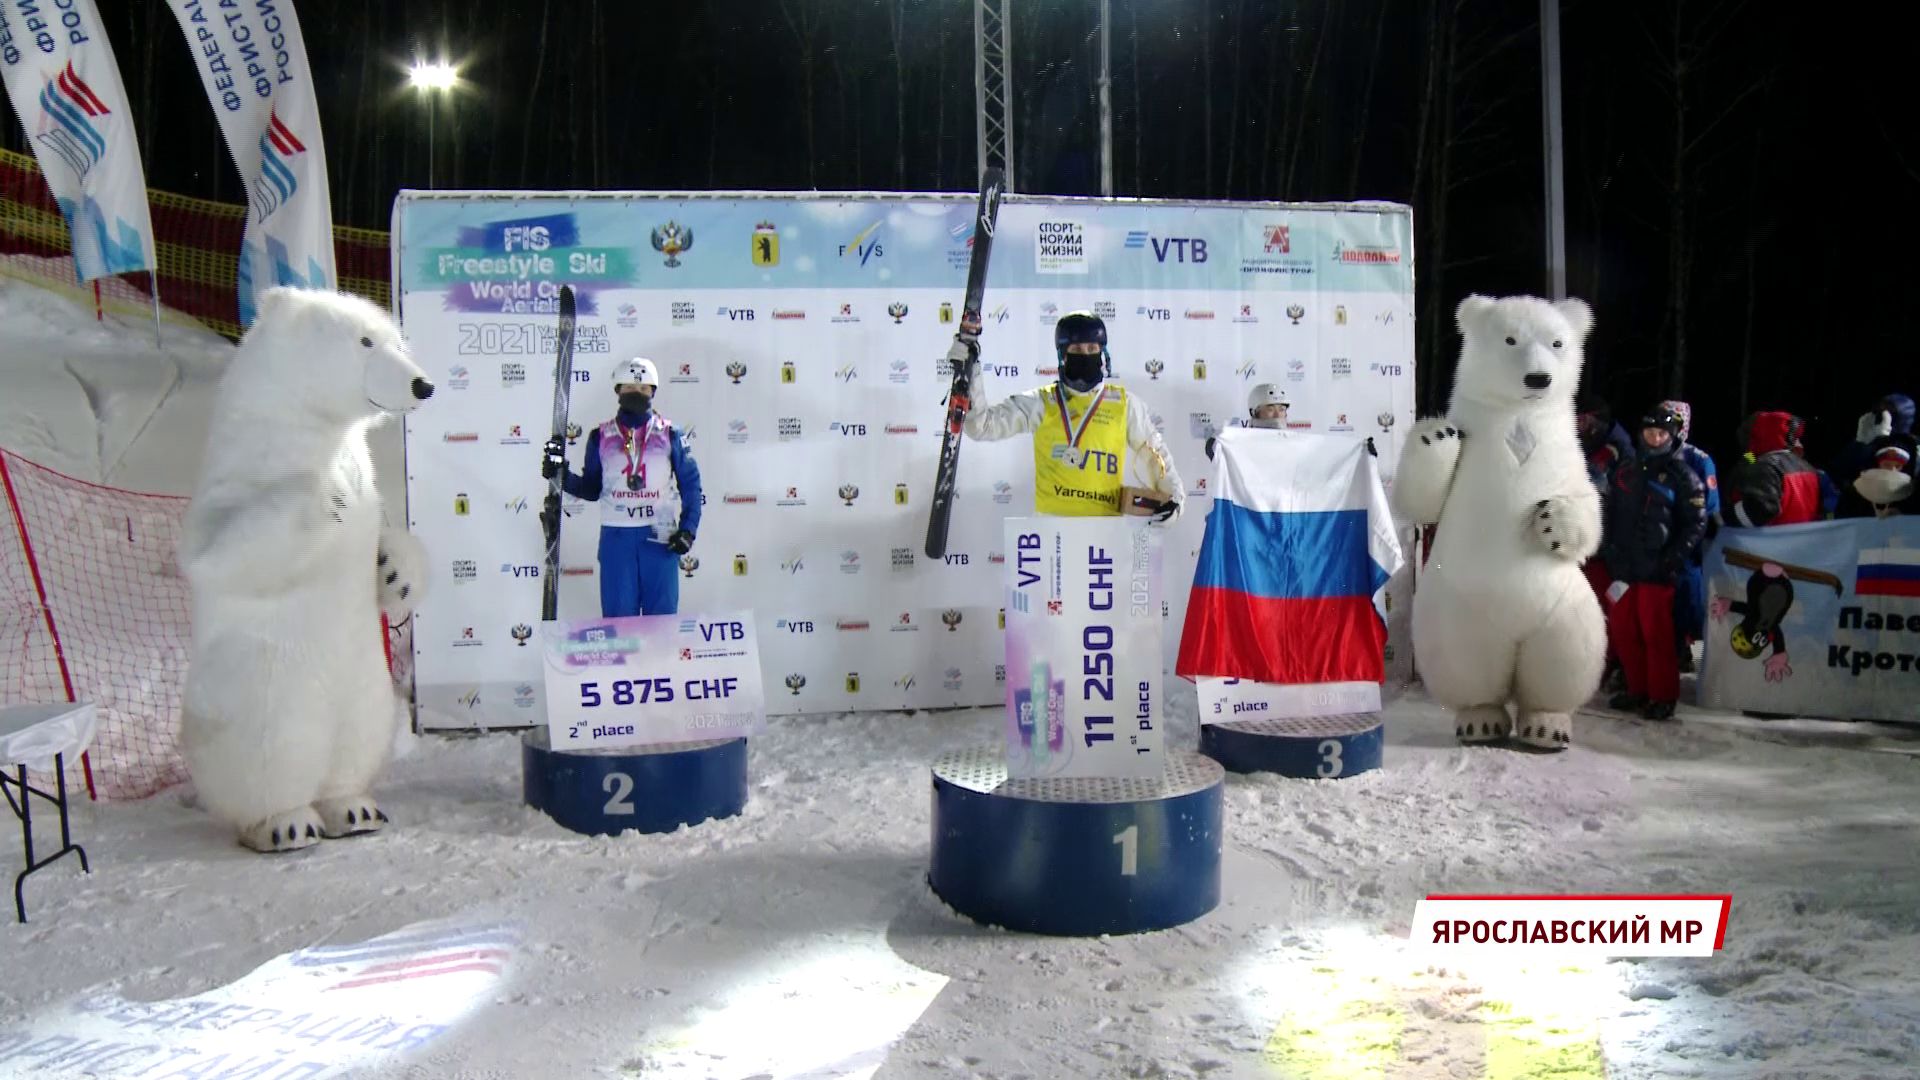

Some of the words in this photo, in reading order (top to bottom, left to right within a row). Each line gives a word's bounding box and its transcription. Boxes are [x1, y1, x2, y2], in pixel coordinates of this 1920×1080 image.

[1039, 222, 1075, 233] СПОРТ
[503, 225, 551, 252] FIS
[1039, 234, 1082, 244] НОРМА
[1040, 245, 1083, 256] ЖИЗНИ
[1151, 238, 1208, 263] VTB
[438, 253, 554, 279] Freestyle
[568, 252, 607, 274] Ski
[470, 280, 531, 299] World
[537, 280, 577, 299] Cu
[728, 309, 755, 321] VTB
[1147, 309, 1171, 321] VTB
[458, 322, 536, 355] 2021
[541, 337, 610, 355] Rssia
[572, 370, 590, 382] TB
[994, 366, 1019, 377] VTB
[1380, 365, 1402, 376] VTB
[841, 424, 866, 436] VTB
[611, 489, 660, 499] Yaroslavl
[627, 505, 655, 518] VTB
[945, 554, 969, 565] VTB
[1018, 533, 1042, 588] VTB
[513, 566, 539, 578] VTB
[1088, 545, 1114, 611] CHF
[789, 622, 814, 633] VTB
[1838, 606, 1920, 633] Паве
[699, 622, 745, 642] VTB
[1083, 625, 1114, 701] 250
[1827, 645, 1920, 677] Крот
[580, 682, 602, 708] 5
[612, 678, 675, 705] 875
[684, 677, 738, 700] CHF
[1136, 681, 1153, 731] place
[1233, 701, 1269, 715] place
[592, 724, 635, 740] place
[1084, 716, 1114, 748] 11
[1316, 739, 1344, 779] 3
[602, 772, 635, 816] 2
[1112, 825, 1138, 876] 1
